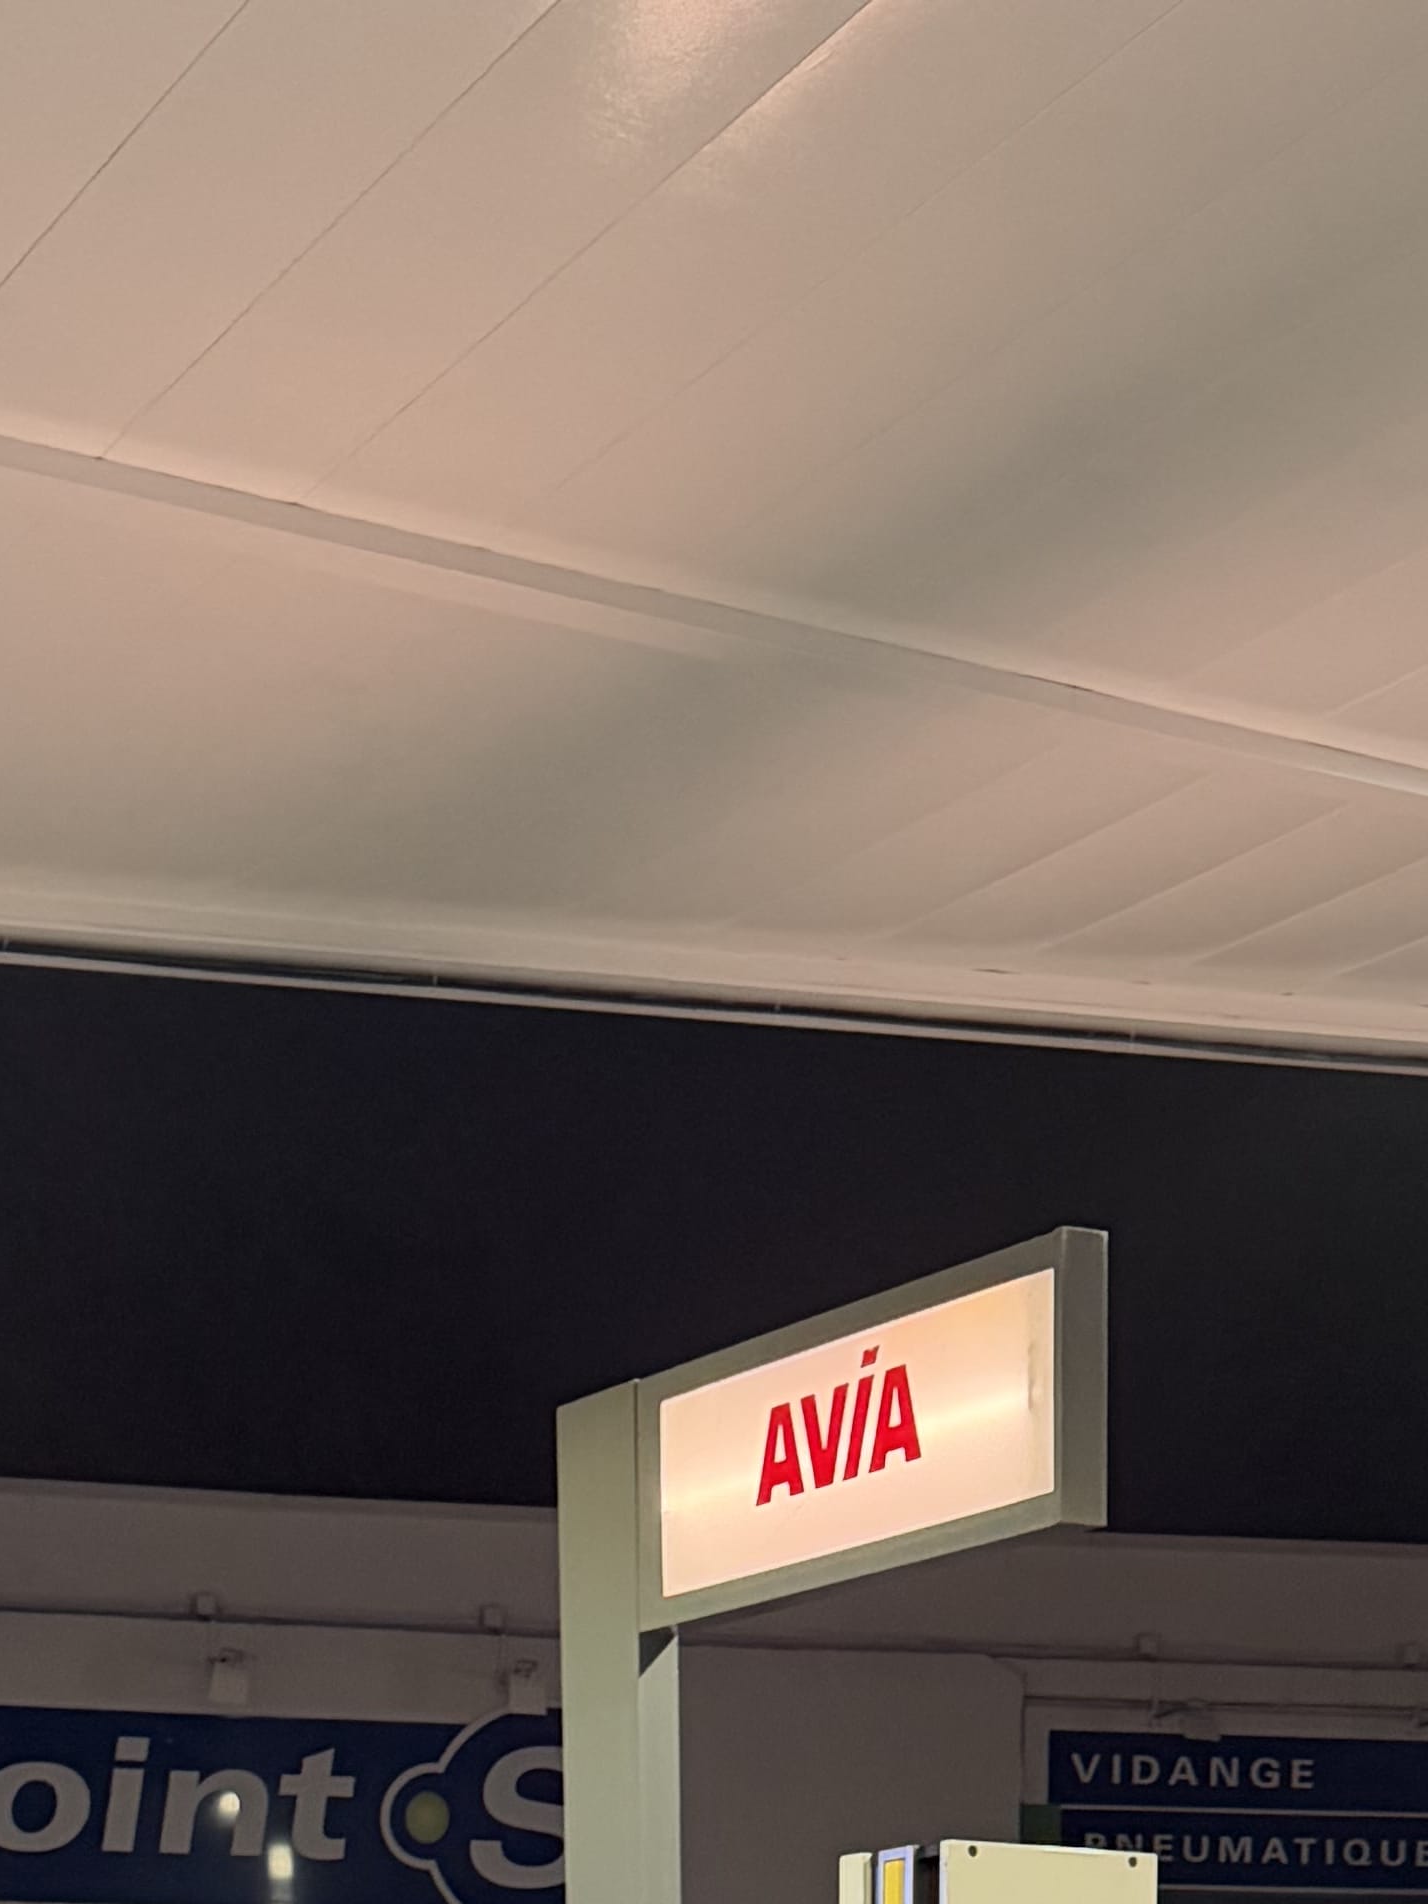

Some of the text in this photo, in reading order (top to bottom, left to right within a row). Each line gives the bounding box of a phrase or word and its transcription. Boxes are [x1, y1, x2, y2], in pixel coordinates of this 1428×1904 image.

[755, 1344, 922, 1507] AVIA
[469, 1745, 563, 1890] S
[1071, 1752, 1316, 1790] VIDANGE
